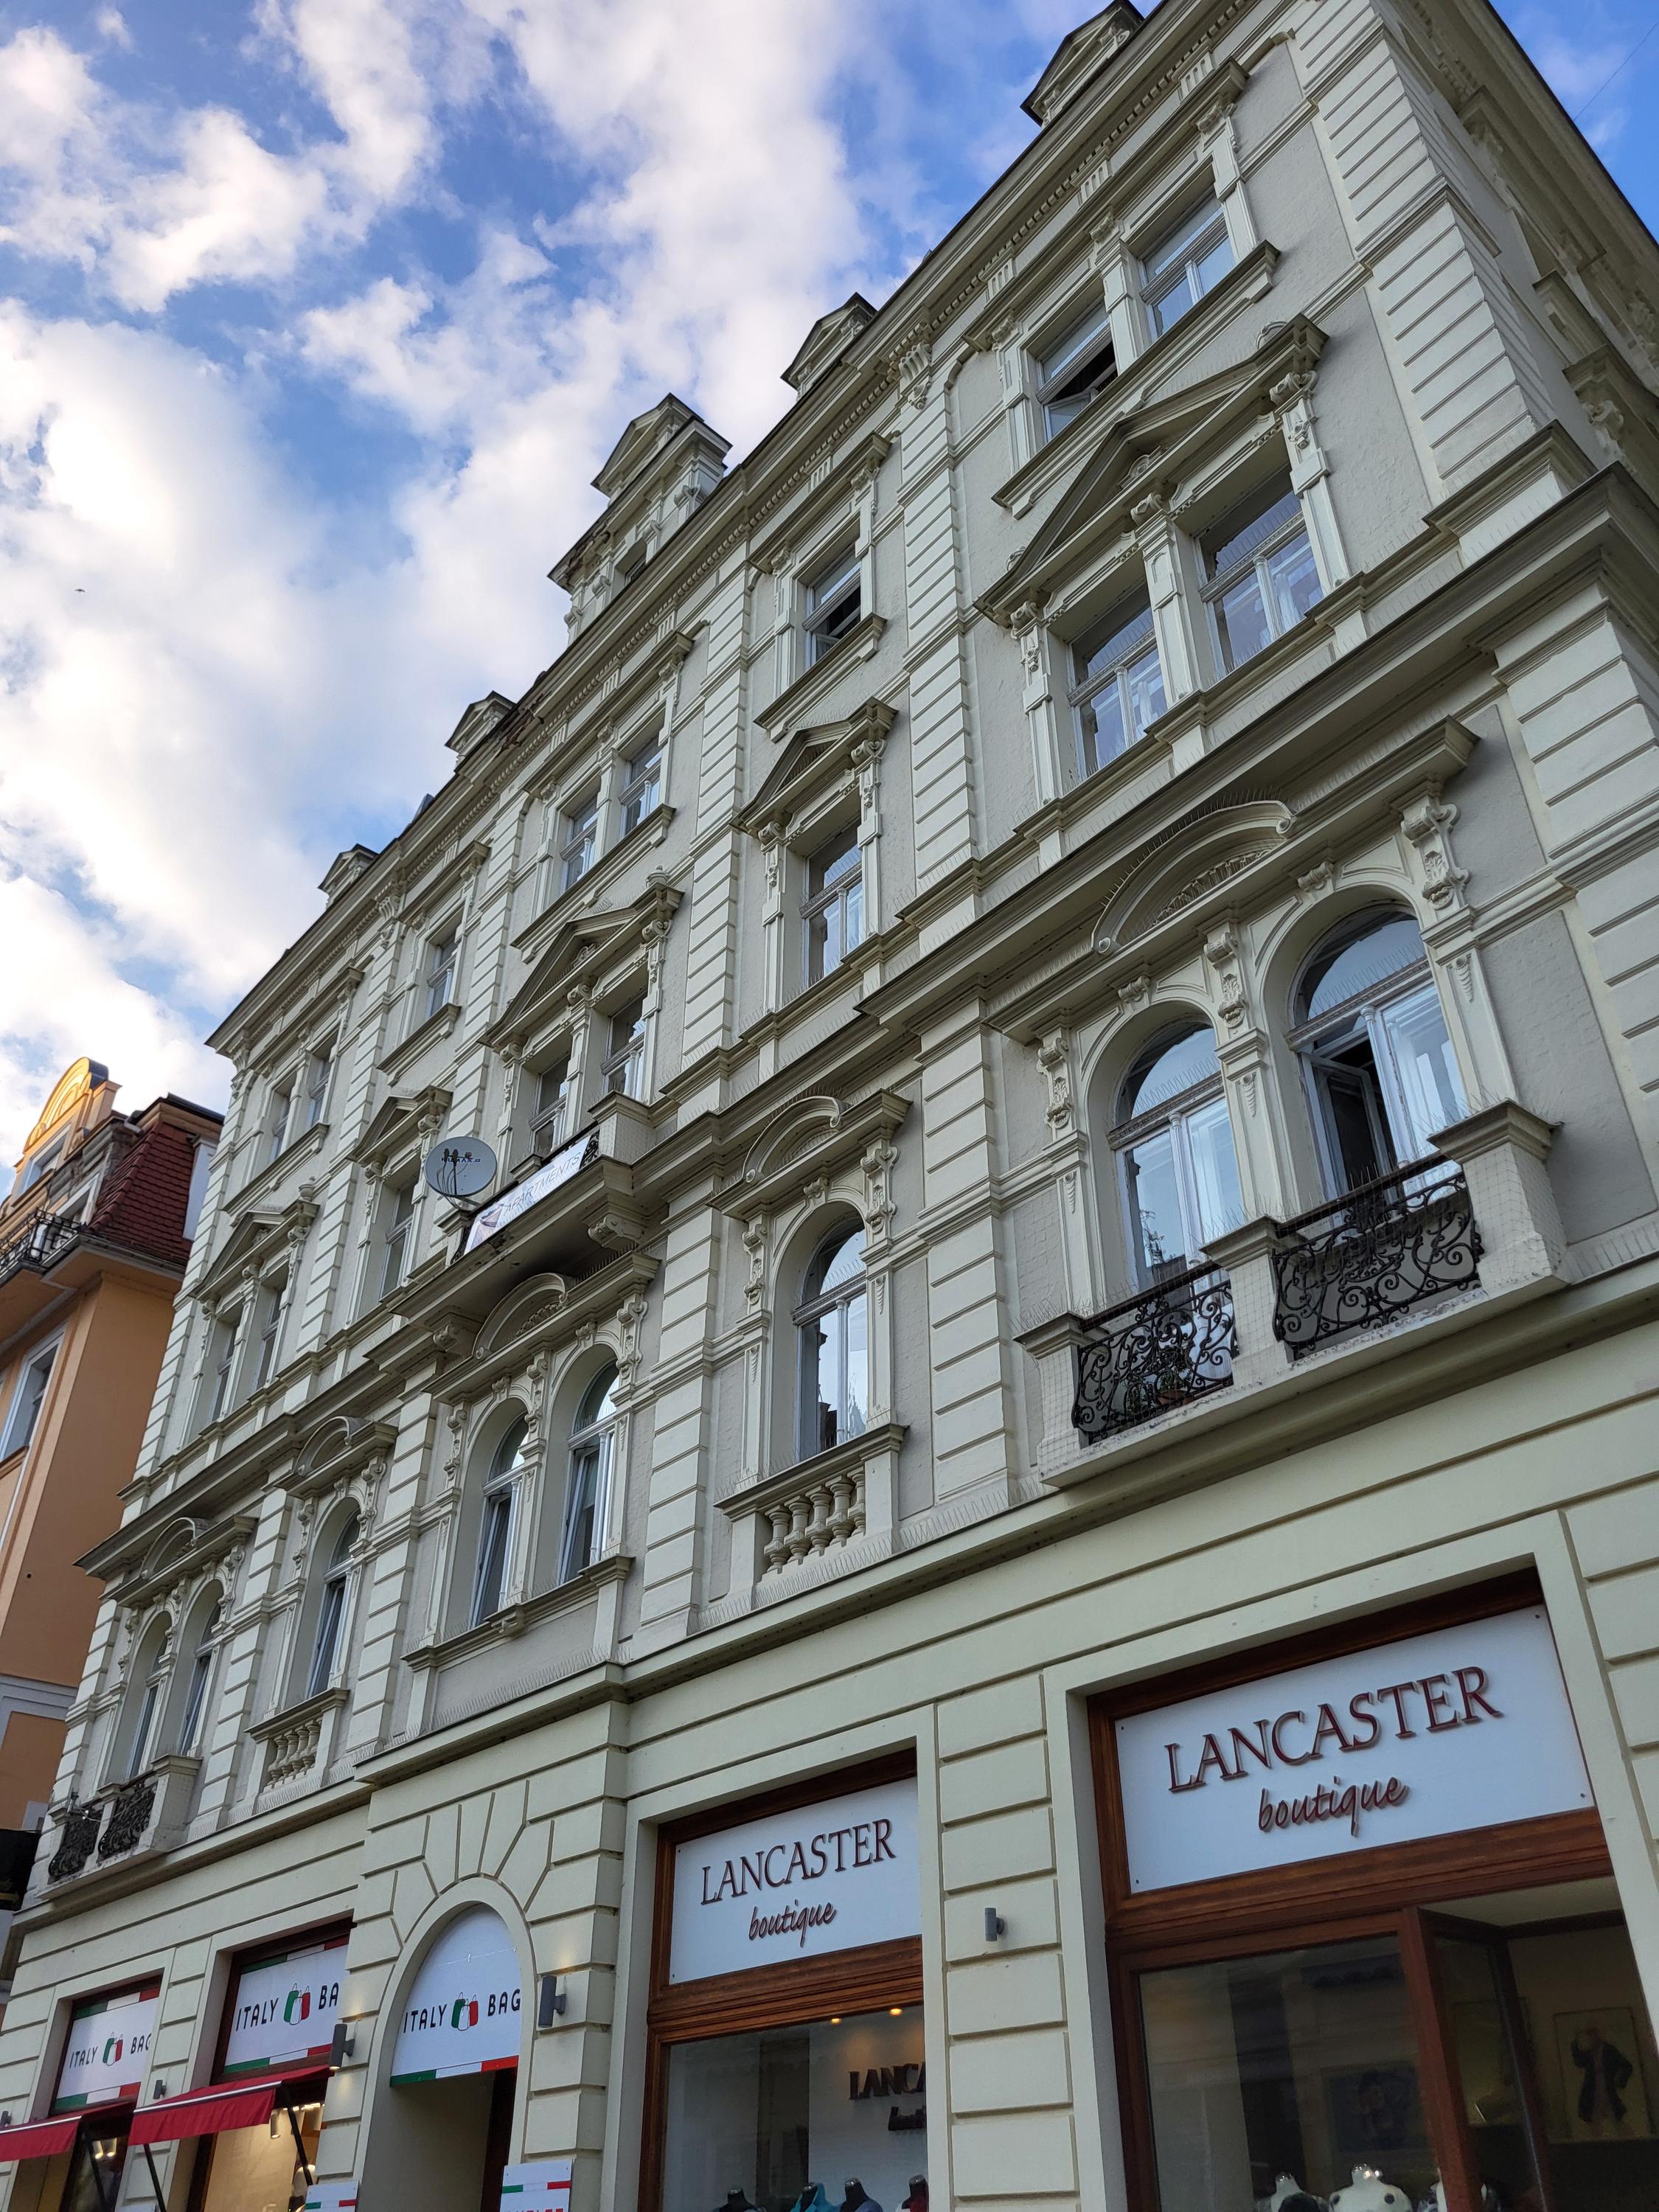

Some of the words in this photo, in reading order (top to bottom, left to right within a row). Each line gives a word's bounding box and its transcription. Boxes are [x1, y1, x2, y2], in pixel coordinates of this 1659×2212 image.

[505, 1152, 581, 1213] APARTMENTS
[1164, 1666, 1503, 1793] LANCASTER
[1258, 1775, 1408, 1836] boutique
[700, 1818, 897, 1905] LANCASTER
[748, 1899, 838, 1947] boutique
[236, 1997, 279, 2031] ITALY
[319, 1982, 339, 2010] BA
[403, 2003, 448, 2034] ITALY
[487, 1989, 521, 2017] BAG
[69, 2046, 98, 2069] ITALY
